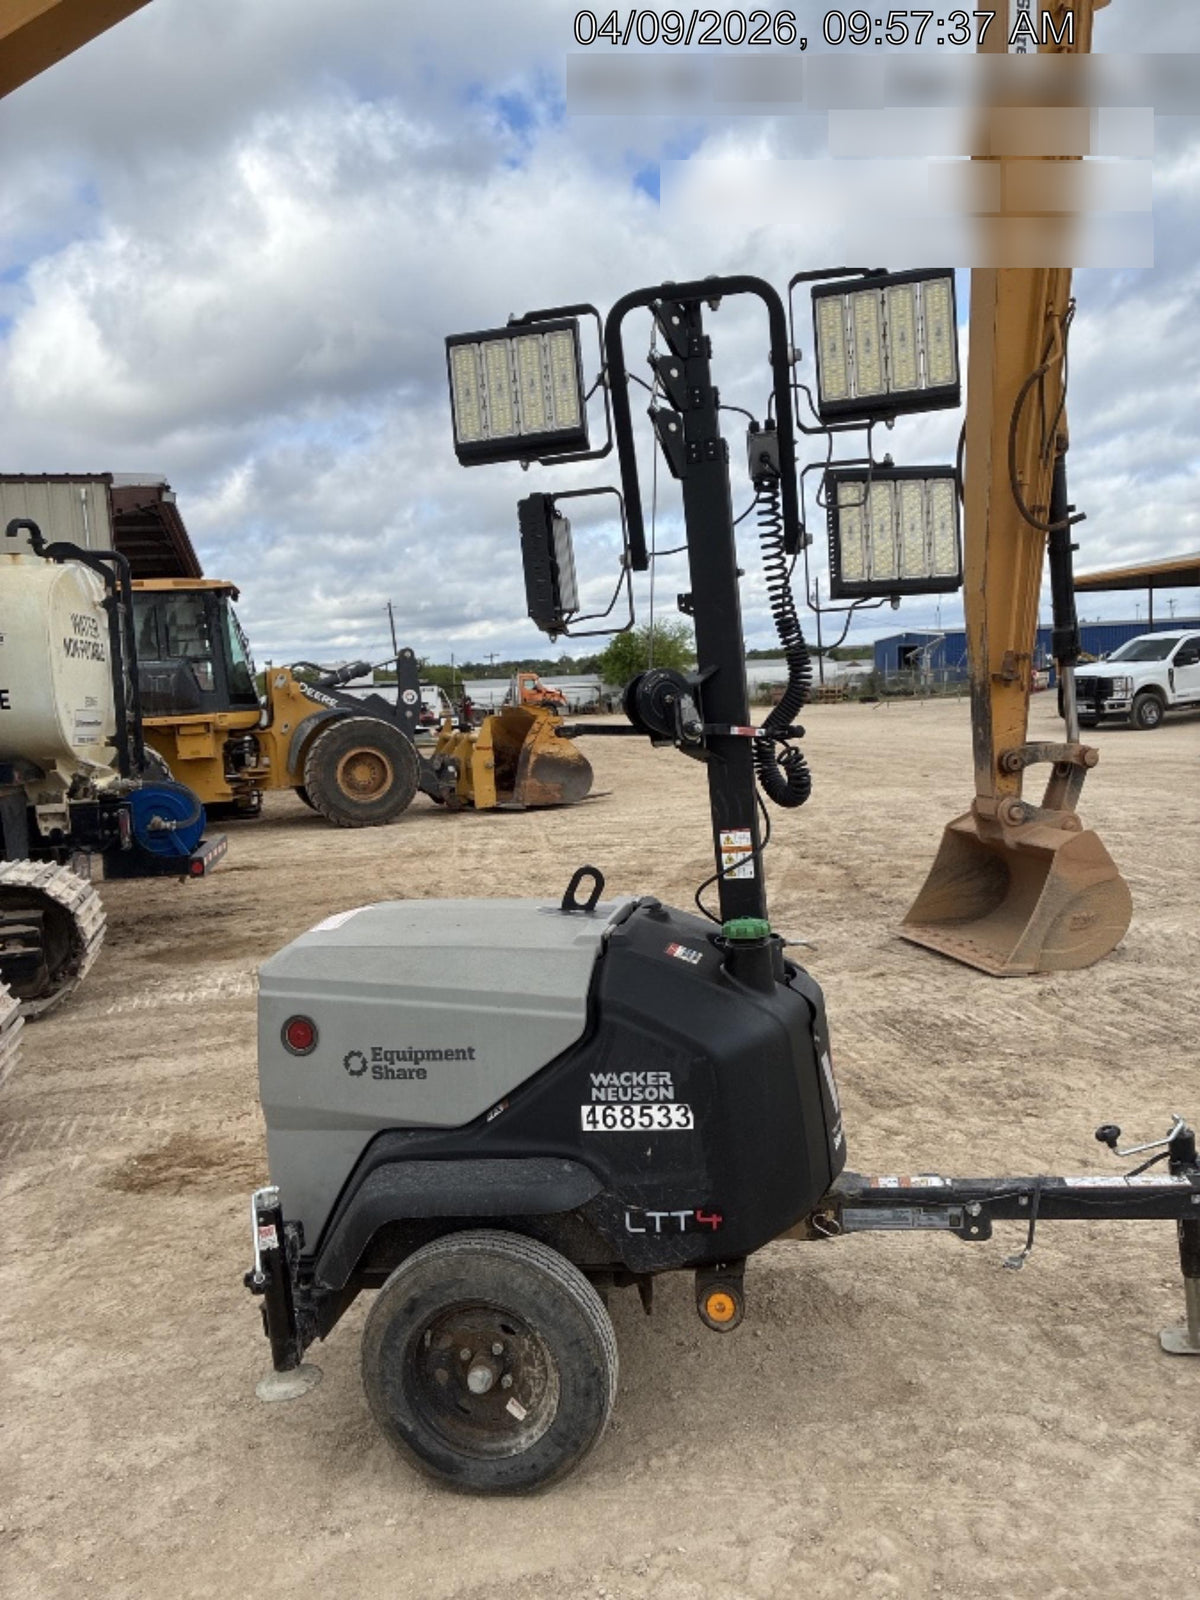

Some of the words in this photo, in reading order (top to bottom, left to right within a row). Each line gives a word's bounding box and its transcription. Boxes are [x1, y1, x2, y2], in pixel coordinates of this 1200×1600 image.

[371, 1046, 476, 1066] Equipment
[371, 1064, 428, 1080] Share
[590, 1071, 673, 1087] WACKER
[591, 1086, 674, 1101] NEUSON
[586, 1104, 691, 1130] 468533
[625, 1210, 722, 1233] LTT4
